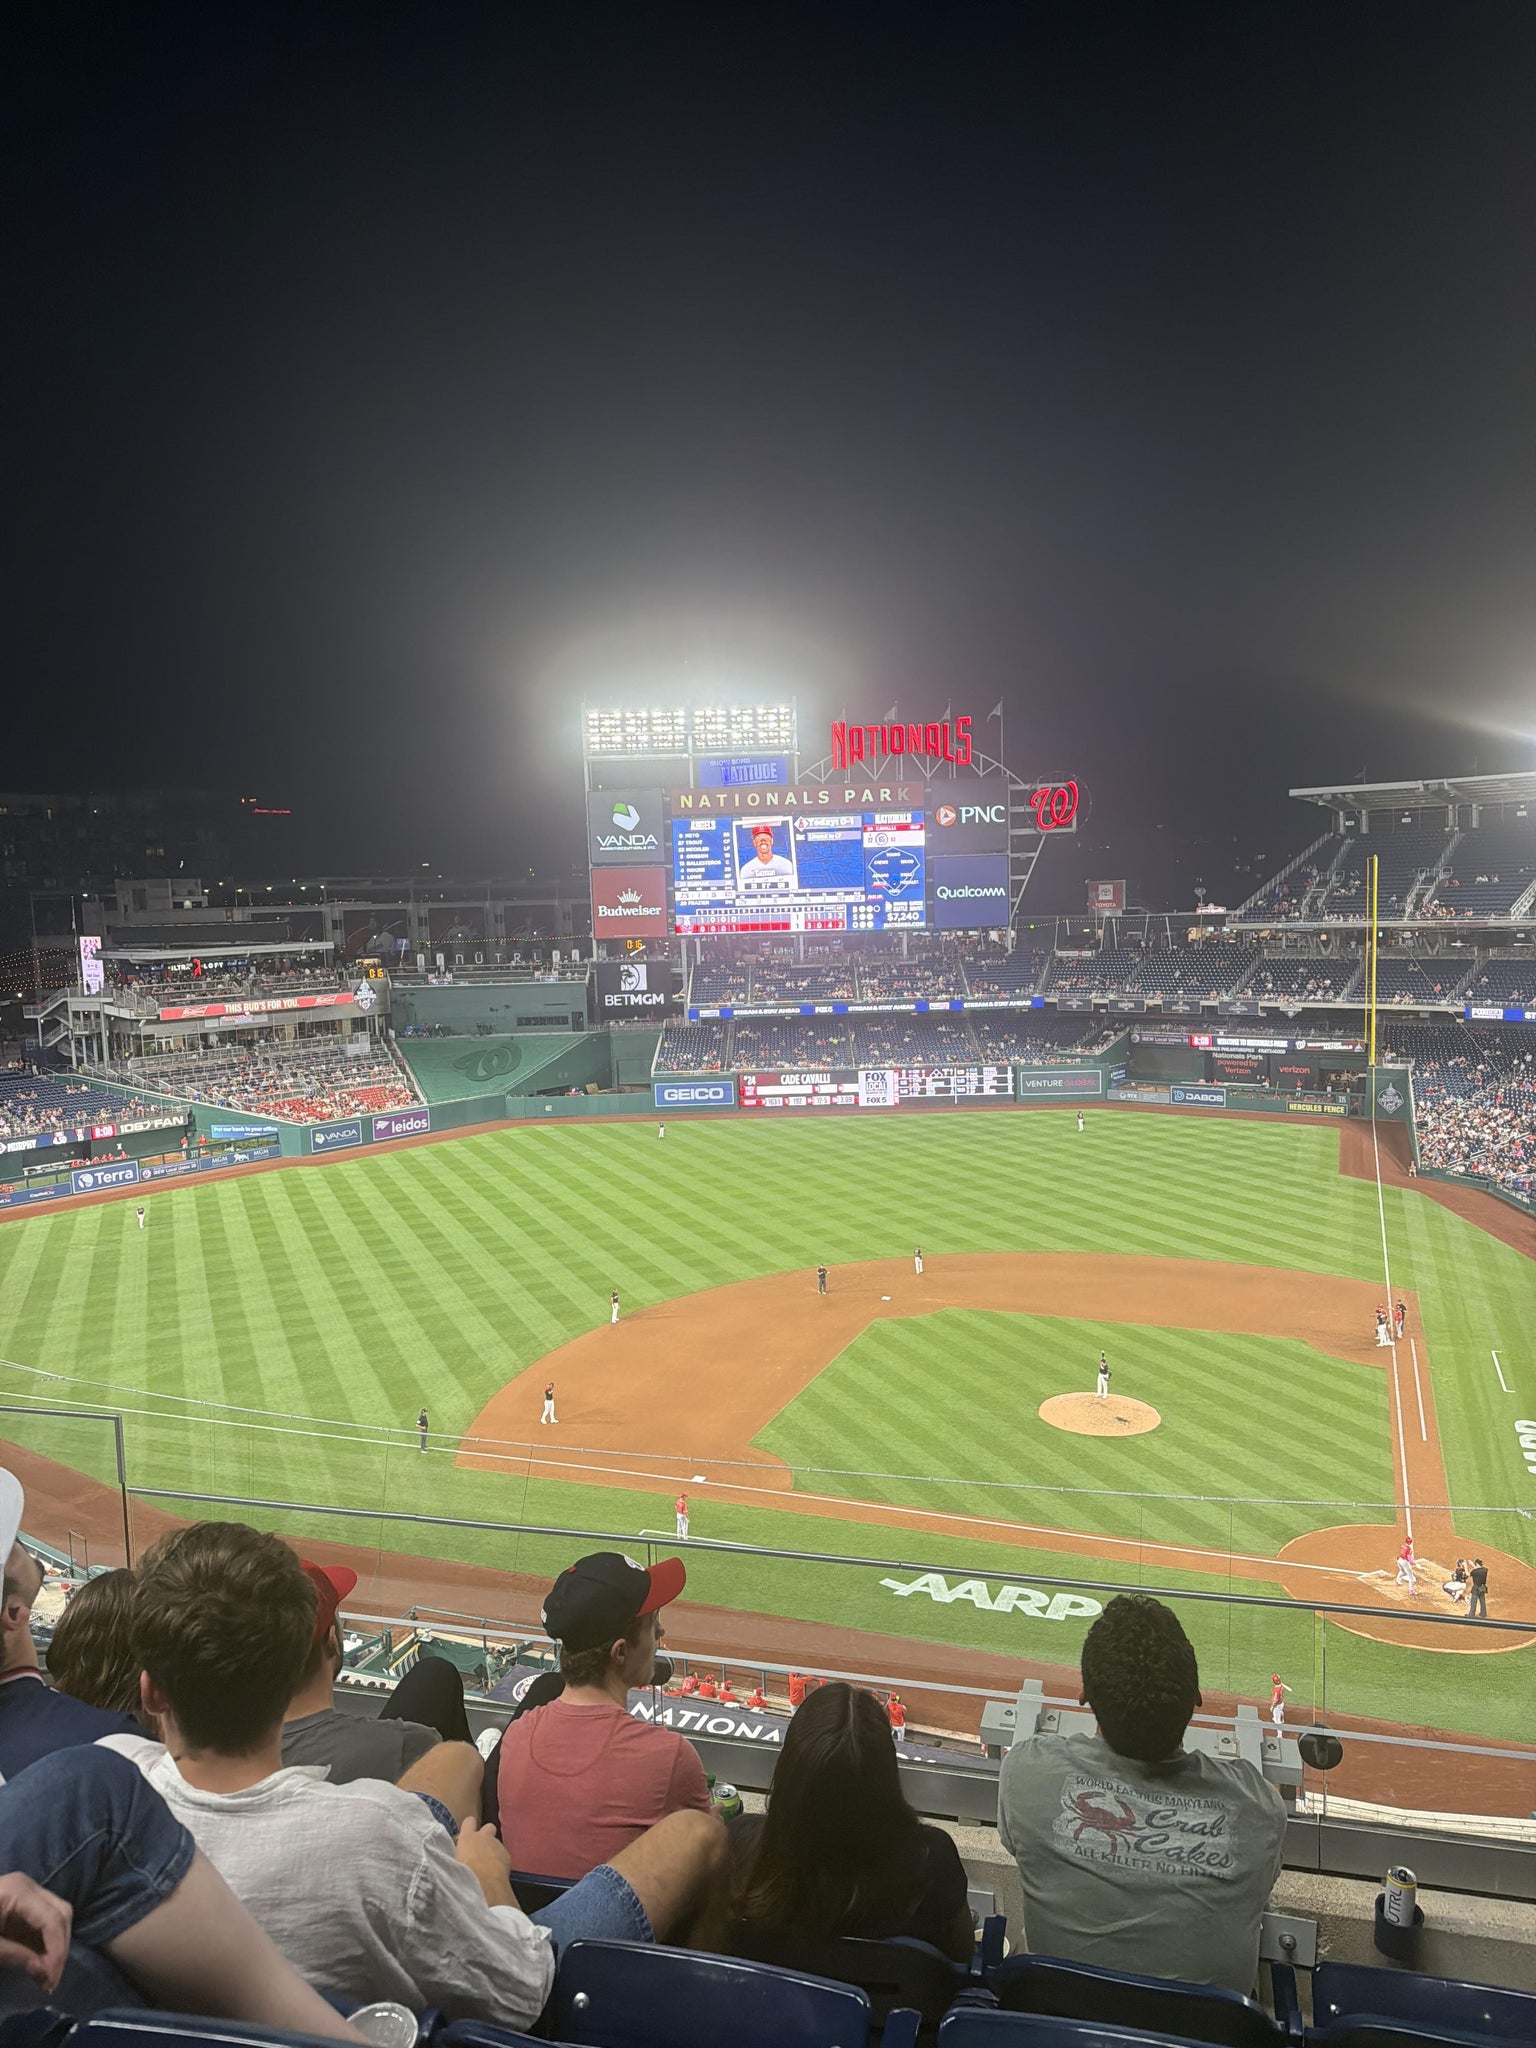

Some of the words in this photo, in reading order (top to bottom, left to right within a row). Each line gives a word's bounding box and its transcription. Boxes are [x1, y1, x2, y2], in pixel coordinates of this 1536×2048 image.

[831, 715, 972, 770] NATIONALS
[722, 762, 777, 784] NATITUDE
[680, 790, 830, 809] NATIONALS
[844, 787, 910, 804] PARK
[1030, 780, 1079, 831] W
[875, 813, 912, 824] NATIONALS
[959, 805, 1006, 824] PNC
[690, 820, 716, 831] ANGELS
[596, 834, 658, 847] VANDA
[936, 884, 1006, 900] Qualcomm
[598, 904, 662, 918] Budweiser
[886, 912, 920, 922] $7,240
[203, 961, 223, 969] LOFT
[604, 993, 665, 1006] BETMGM
[224, 1004, 242, 1014] THIS
[244, 1002, 266, 1012] BUD'S
[267, 1000, 282, 1010] FOR
[282, 998, 299, 1008] YOU.
[734, 1008, 758, 1016] STREAM
[1212, 1052, 1245, 1060] Nationals
[1217, 1060, 1249, 1068] powered
[1250, 1060, 1258, 1068] by
[1224, 1066, 1251, 1074] Verizon
[1278, 1066, 1310, 1074] verizon
[780, 1074, 800, 1084] CADE
[800, 1073, 830, 1084] CAVALLI
[866, 1072, 886, 1082] FOX
[1026, 1080, 1064, 1088] VENTURE
[1064, 1078, 1097, 1087] GLOBAL
[866, 1082, 888, 1091] LOCAL
[663, 1086, 724, 1101] GEICO
[1186, 1093, 1224, 1102] DABOS
[866, 1096, 880, 1104] FOX
[882, 1096, 887, 1104] 5
[1288, 1104, 1322, 1113] HERCULES
[1324, 1105, 1346, 1114] FENCE
[154, 1116, 184, 1129] FAN
[392, 1117, 428, 1134] leidos
[94, 1126, 114, 1138] 8:08
[324, 1130, 358, 1141] VANDA
[6, 1138, 37, 1152] MURPHY
[190, 1150, 198, 1158] 377
[253, 1148, 269, 1156] MGM
[212, 1156, 228, 1164] MGM
[96, 1168, 134, 1185] Terra
[879, 1572, 1103, 1621] AARP
[1076, 1775, 1114, 1792] WORLD
[1164, 1796, 1225, 1810] MARYLAND
[1145, 1808, 1227, 1838] Crab
[1133, 1831, 1234, 1869] Cakes
[1073, 1845, 1096, 1860] ALL
[1101, 1850, 1150, 1869] KILLER
[1156, 1861, 1176, 1874] NO
